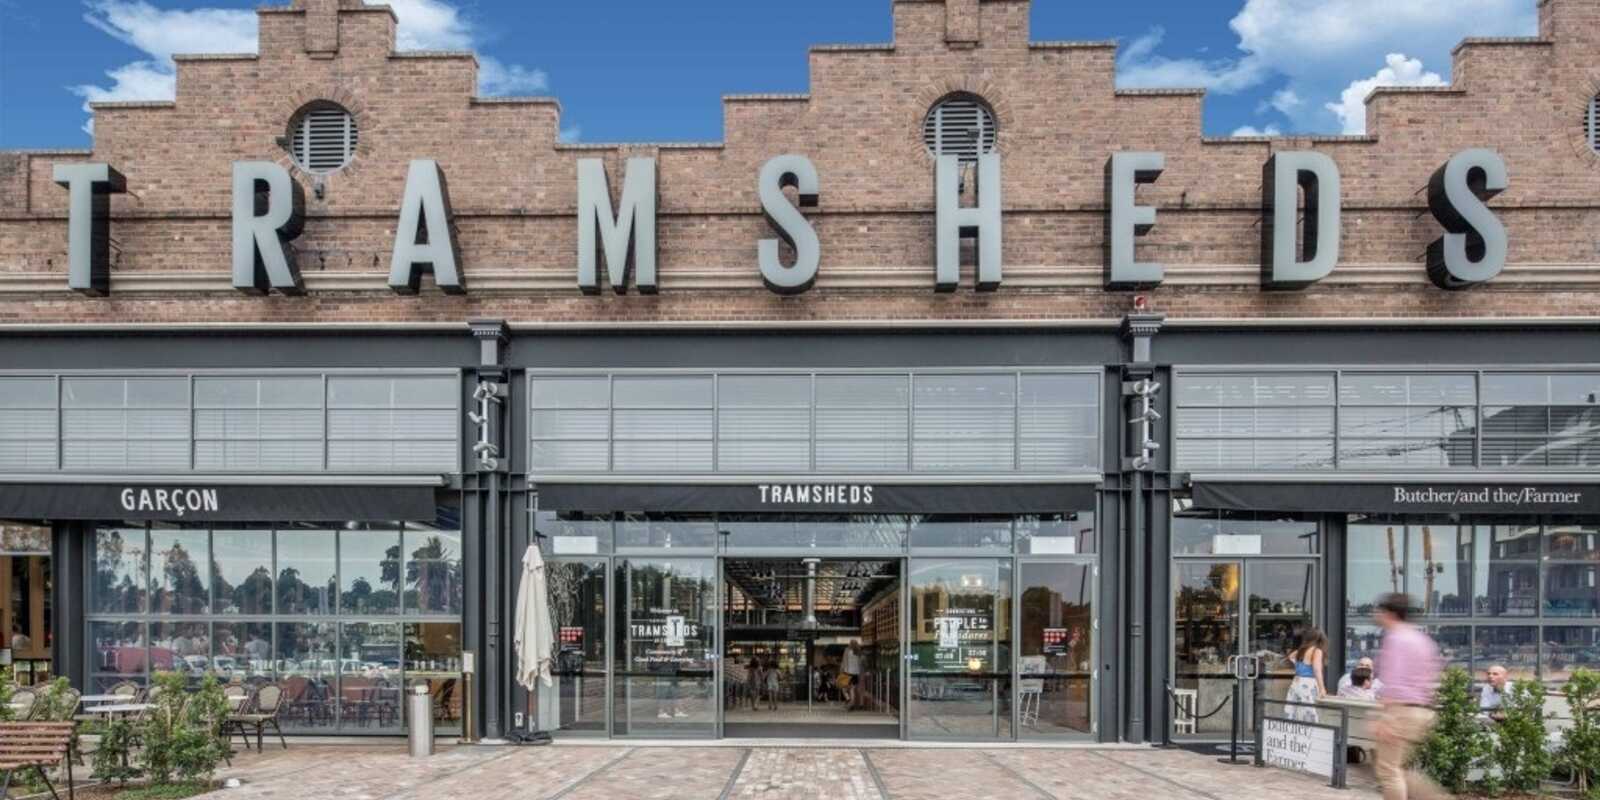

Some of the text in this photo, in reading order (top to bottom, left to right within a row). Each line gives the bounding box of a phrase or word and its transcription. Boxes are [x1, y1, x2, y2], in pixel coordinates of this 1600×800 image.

[53, 147, 1509, 295] TRAMSHEDS
[121, 488, 218, 516] GARÇON
[758, 485, 873, 504] TRAMSHEDS
[631, 625, 698, 636] TRAMSDS
[934, 617, 977, 629] PPLE
[1266, 735, 1287, 750] and
